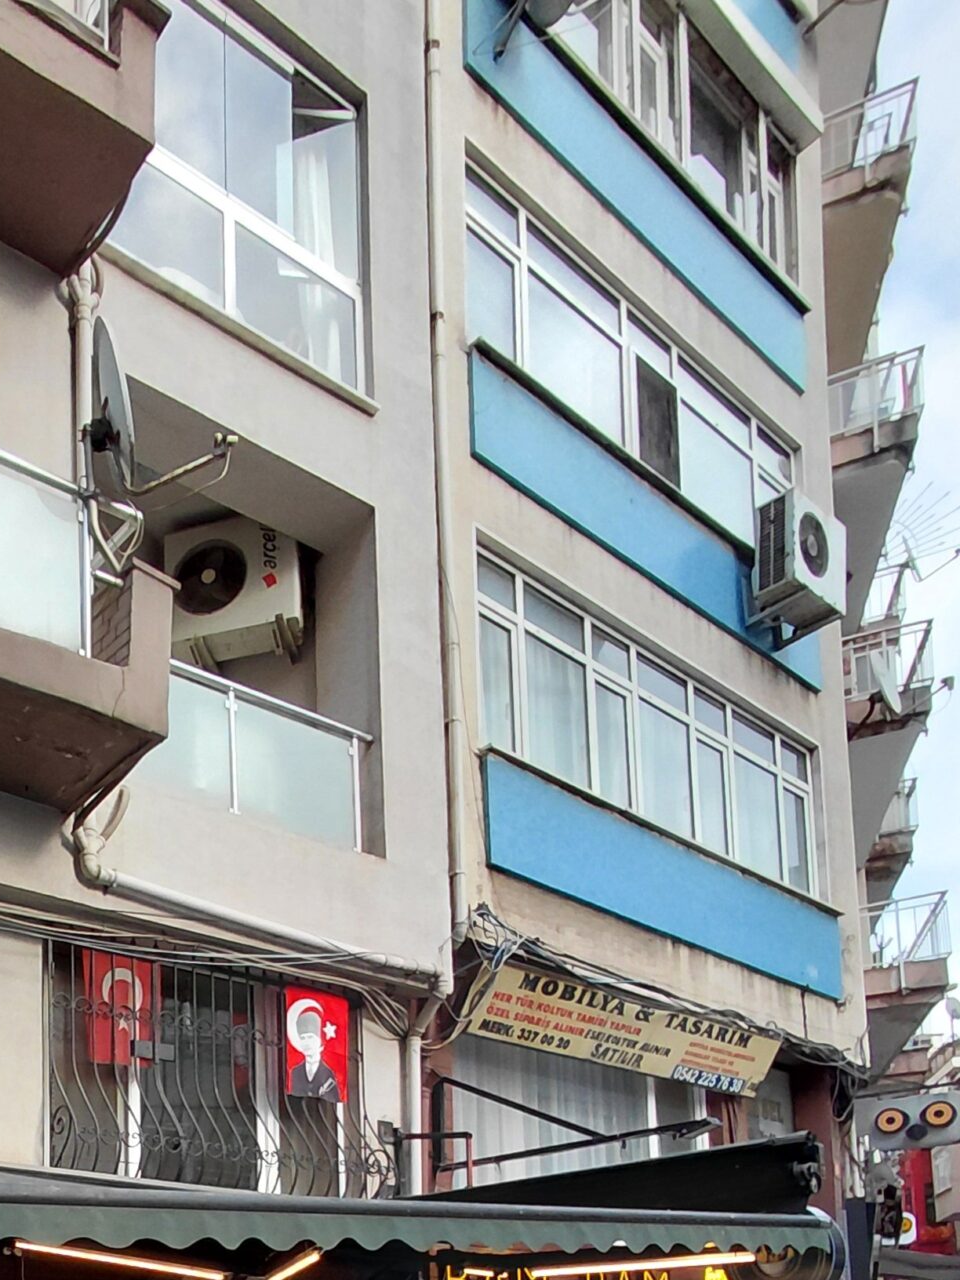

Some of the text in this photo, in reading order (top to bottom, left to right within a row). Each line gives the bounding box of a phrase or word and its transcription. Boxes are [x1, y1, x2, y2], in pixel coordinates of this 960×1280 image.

[486, 1003, 510, 1019] ÖZEL
[492, 991, 513, 1004] HER
[535, 1002, 574, 1020] KOLTUK
[517, 1028, 539, 1043] 337
[540, 1033, 555, 1047] 00
[556, 1037, 571, 1050] 20
[664, 1013, 753, 1049] TASARIM
